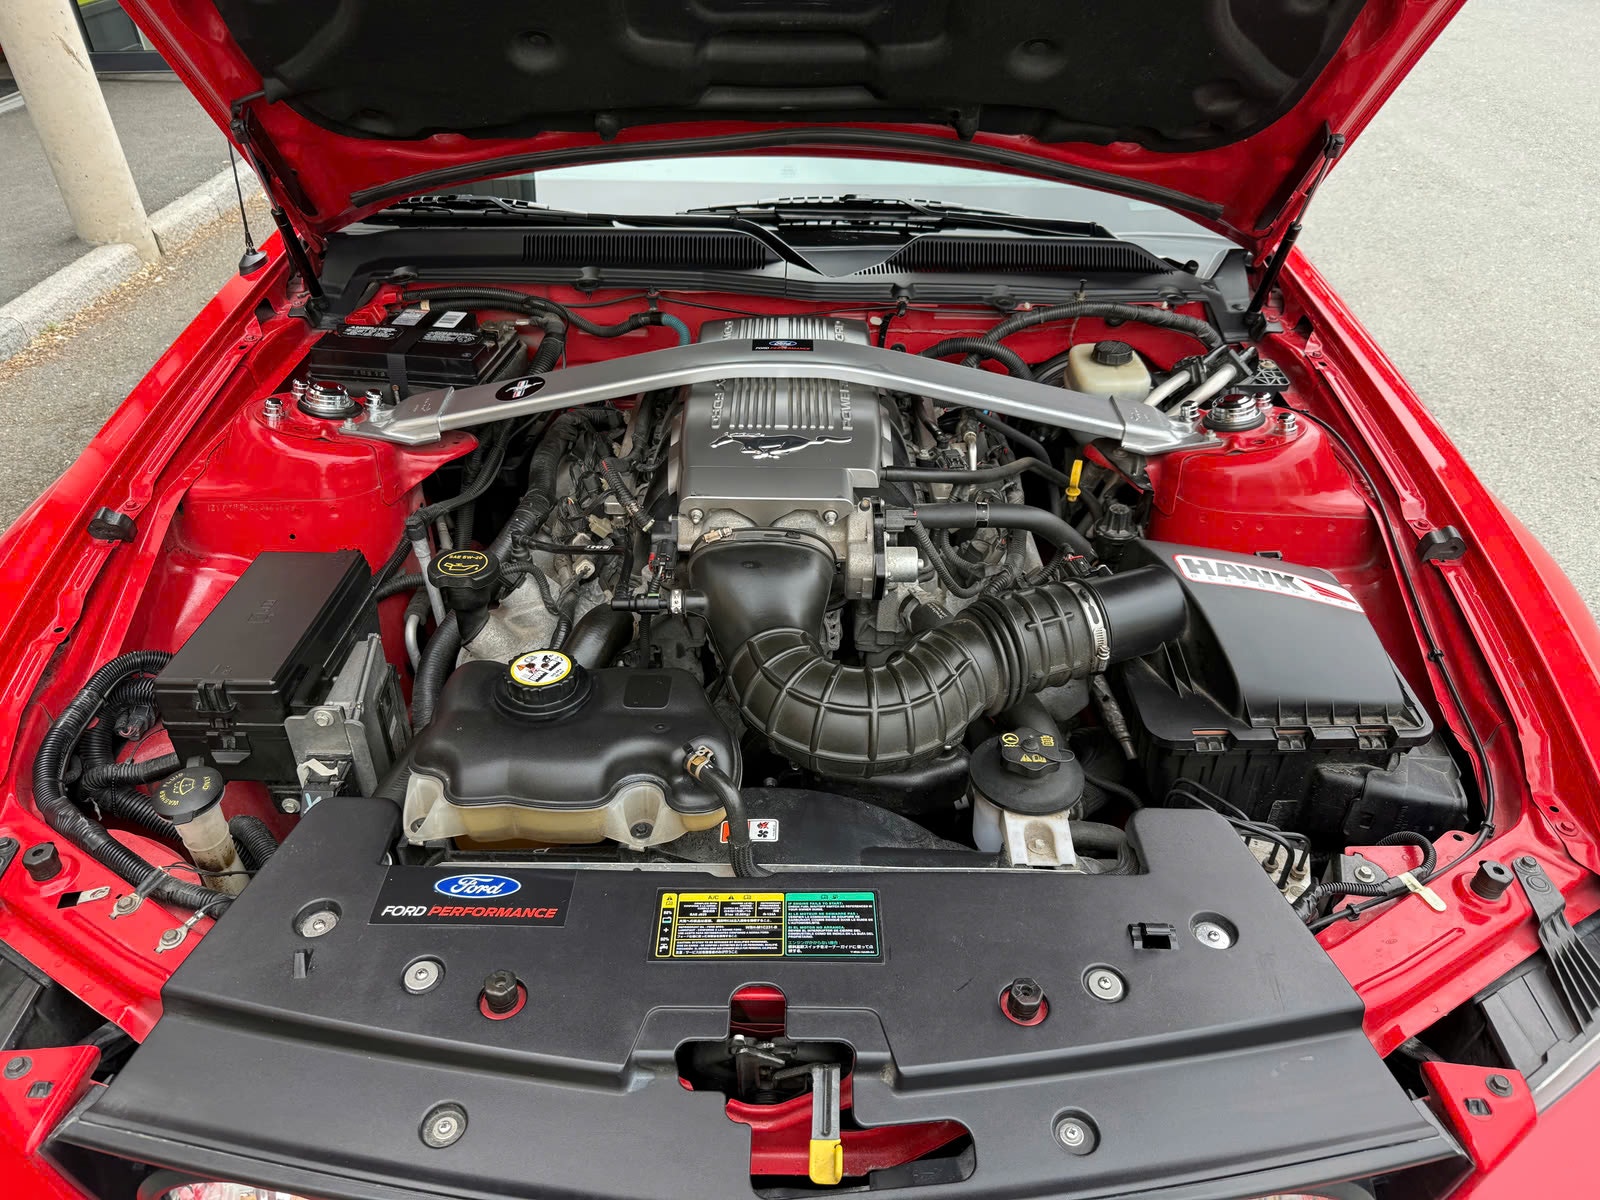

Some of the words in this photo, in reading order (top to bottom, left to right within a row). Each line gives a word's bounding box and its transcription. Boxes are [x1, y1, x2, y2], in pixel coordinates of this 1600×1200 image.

[1182, 558, 1305, 592] HAWK
[450, 877, 505, 895] Ford
[381, 905, 427, 917] FORD
[427, 906, 558, 918] PERFORMANCE
